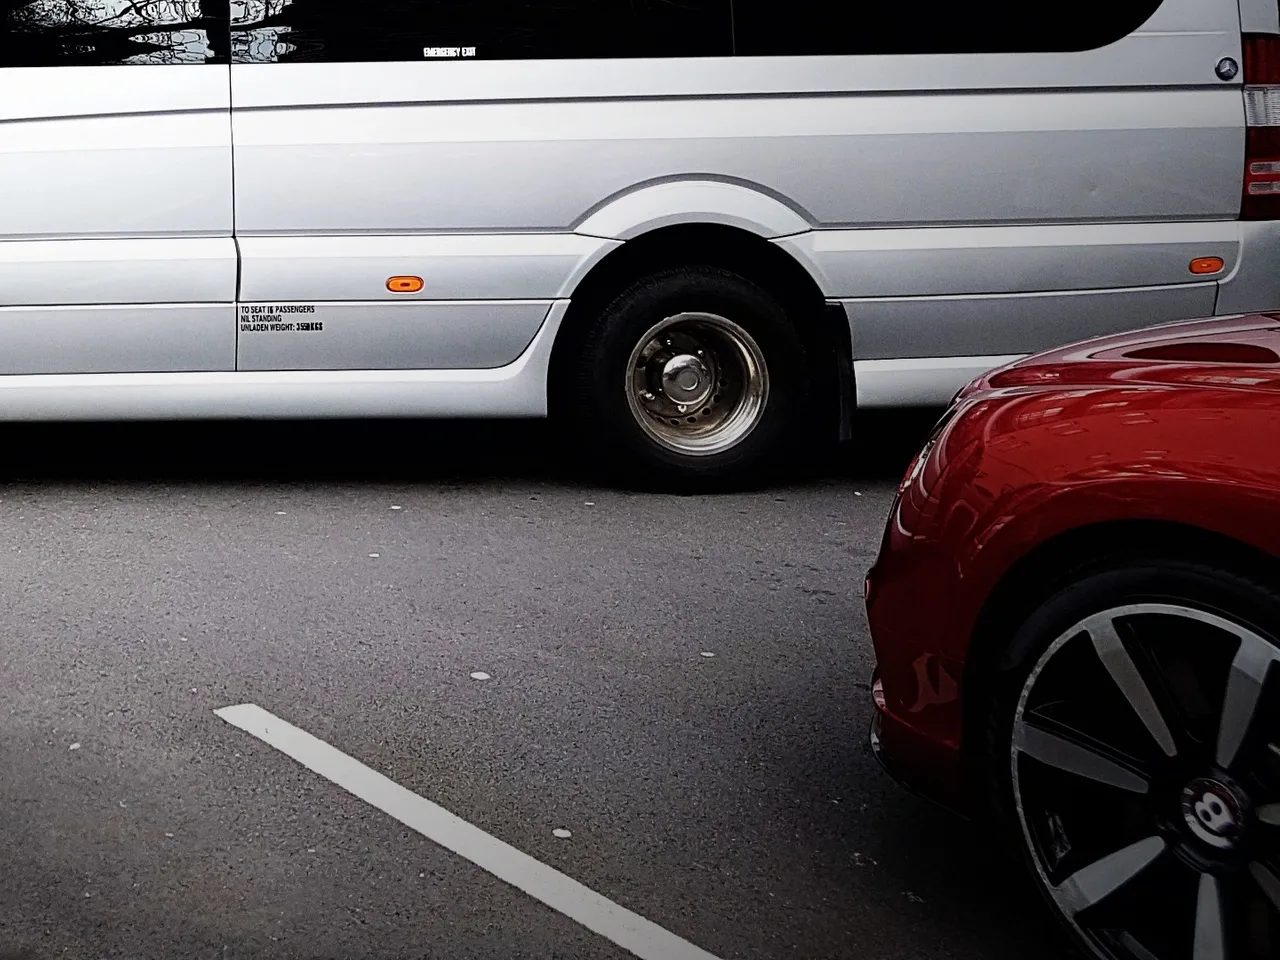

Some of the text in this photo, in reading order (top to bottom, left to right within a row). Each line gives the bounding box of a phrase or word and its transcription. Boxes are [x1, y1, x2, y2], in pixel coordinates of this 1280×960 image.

[240, 305, 250, 314] TO
[250, 305, 266, 314] SEAT
[275, 305, 316, 314] PASSENGERS
[251, 314, 282, 323] STANDING
[240, 323, 269, 332] UNLADEN
[269, 323, 295, 332] WEIGHT:
